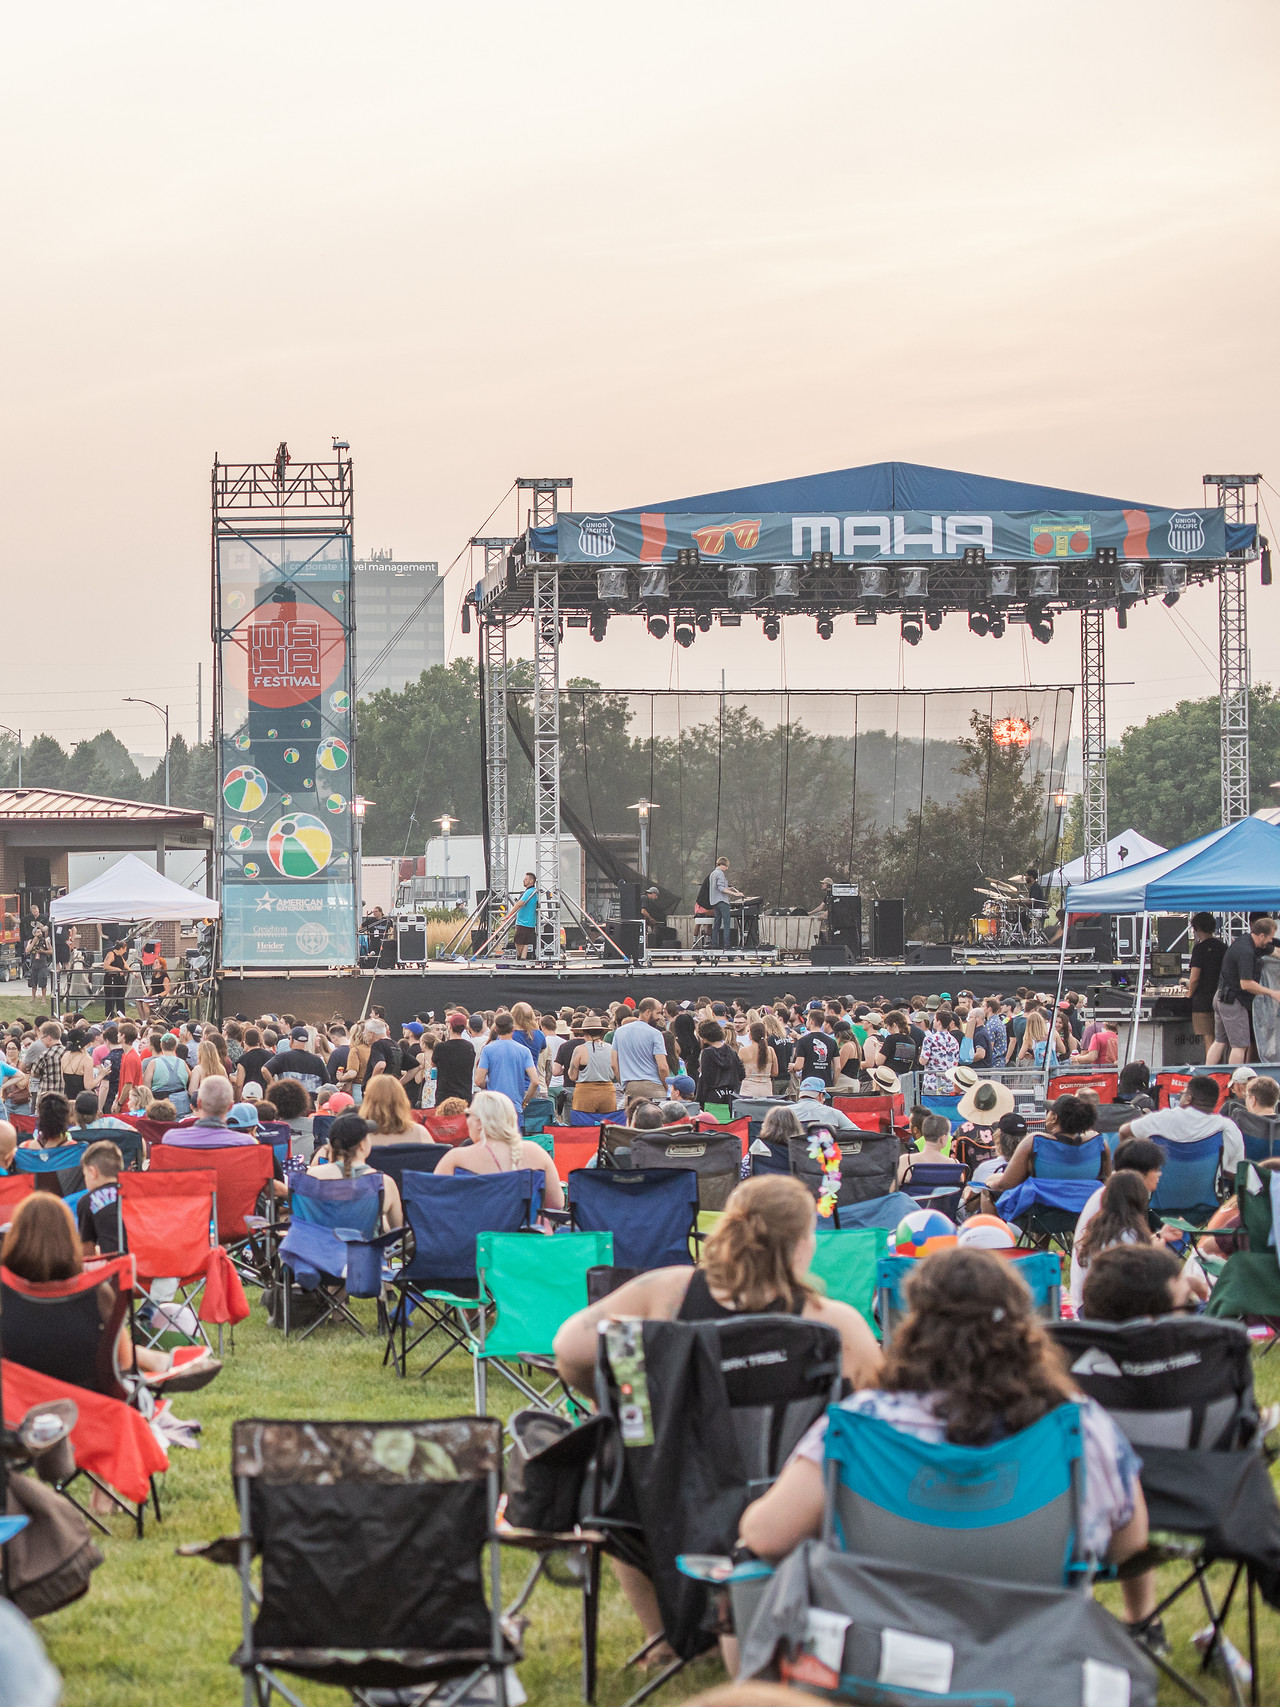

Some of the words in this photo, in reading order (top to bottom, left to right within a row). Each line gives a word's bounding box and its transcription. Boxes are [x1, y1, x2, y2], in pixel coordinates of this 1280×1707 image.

[791, 515, 993, 556] MAHA
[369, 562, 436, 573] management
[253, 676, 320, 687] FESTIVAL
[276, 898, 323, 906] AMERICAN
[253, 925, 287, 934] Creighton
[257, 941, 284, 949] Heider
